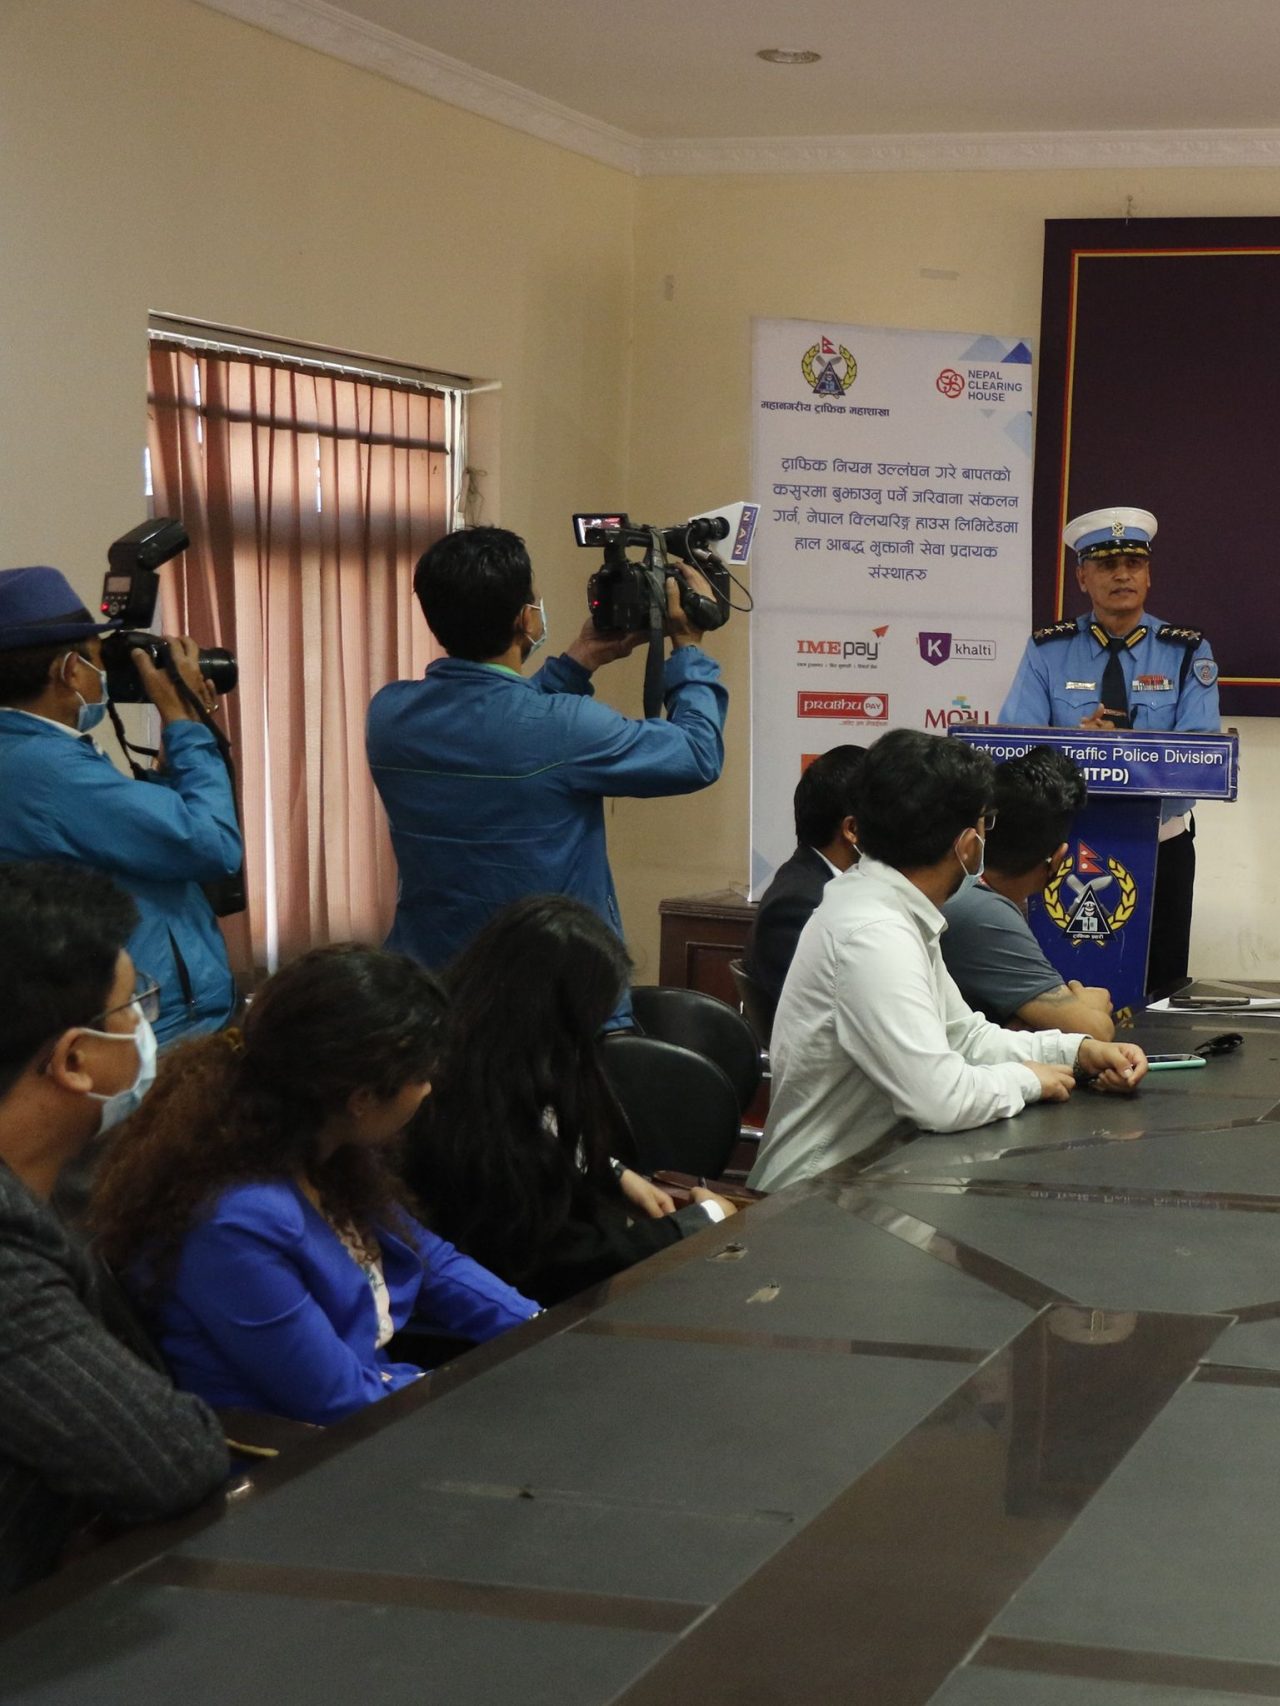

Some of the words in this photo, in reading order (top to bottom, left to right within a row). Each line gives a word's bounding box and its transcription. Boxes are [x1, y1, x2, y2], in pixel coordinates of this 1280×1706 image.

[968, 369, 1003, 380] NEPAL
[968, 380, 1023, 391] CLEARING
[968, 391, 1005, 402] HOUSE
[782, 456, 827, 475] ट्राफिक
[833, 458, 872, 474] नियम
[877, 461, 929, 478] उल्लंघन
[935, 463, 956, 480] गरे
[962, 465, 1011, 482] बापतको
[773, 483, 827, 500] कसुरमा
[832, 486, 882, 504] बुझाउनु
[887, 486, 908, 503] पर्ने
[912, 489, 963, 506] जरिवाना
[968, 491, 1019, 508] संकलन
[806, 508, 843, 525] नेपाल
[915, 517, 950, 531] हाउस
[954, 516, 1019, 534] लिमिटेडमा
[794, 537, 821, 551] हाल
[826, 538, 865, 555] आबद्ध
[869, 539, 914, 557] भुक्तानी
[920, 540, 945, 556] सेवा
[950, 545, 999, 560] प्रदायक
[868, 565, 928, 582] संस्थाहरु
[955, 644, 991, 656] khalti
[1062, 745, 1107, 760] Traffic
[1112, 747, 1159, 762] Police
[1164, 749, 1223, 765] Division
